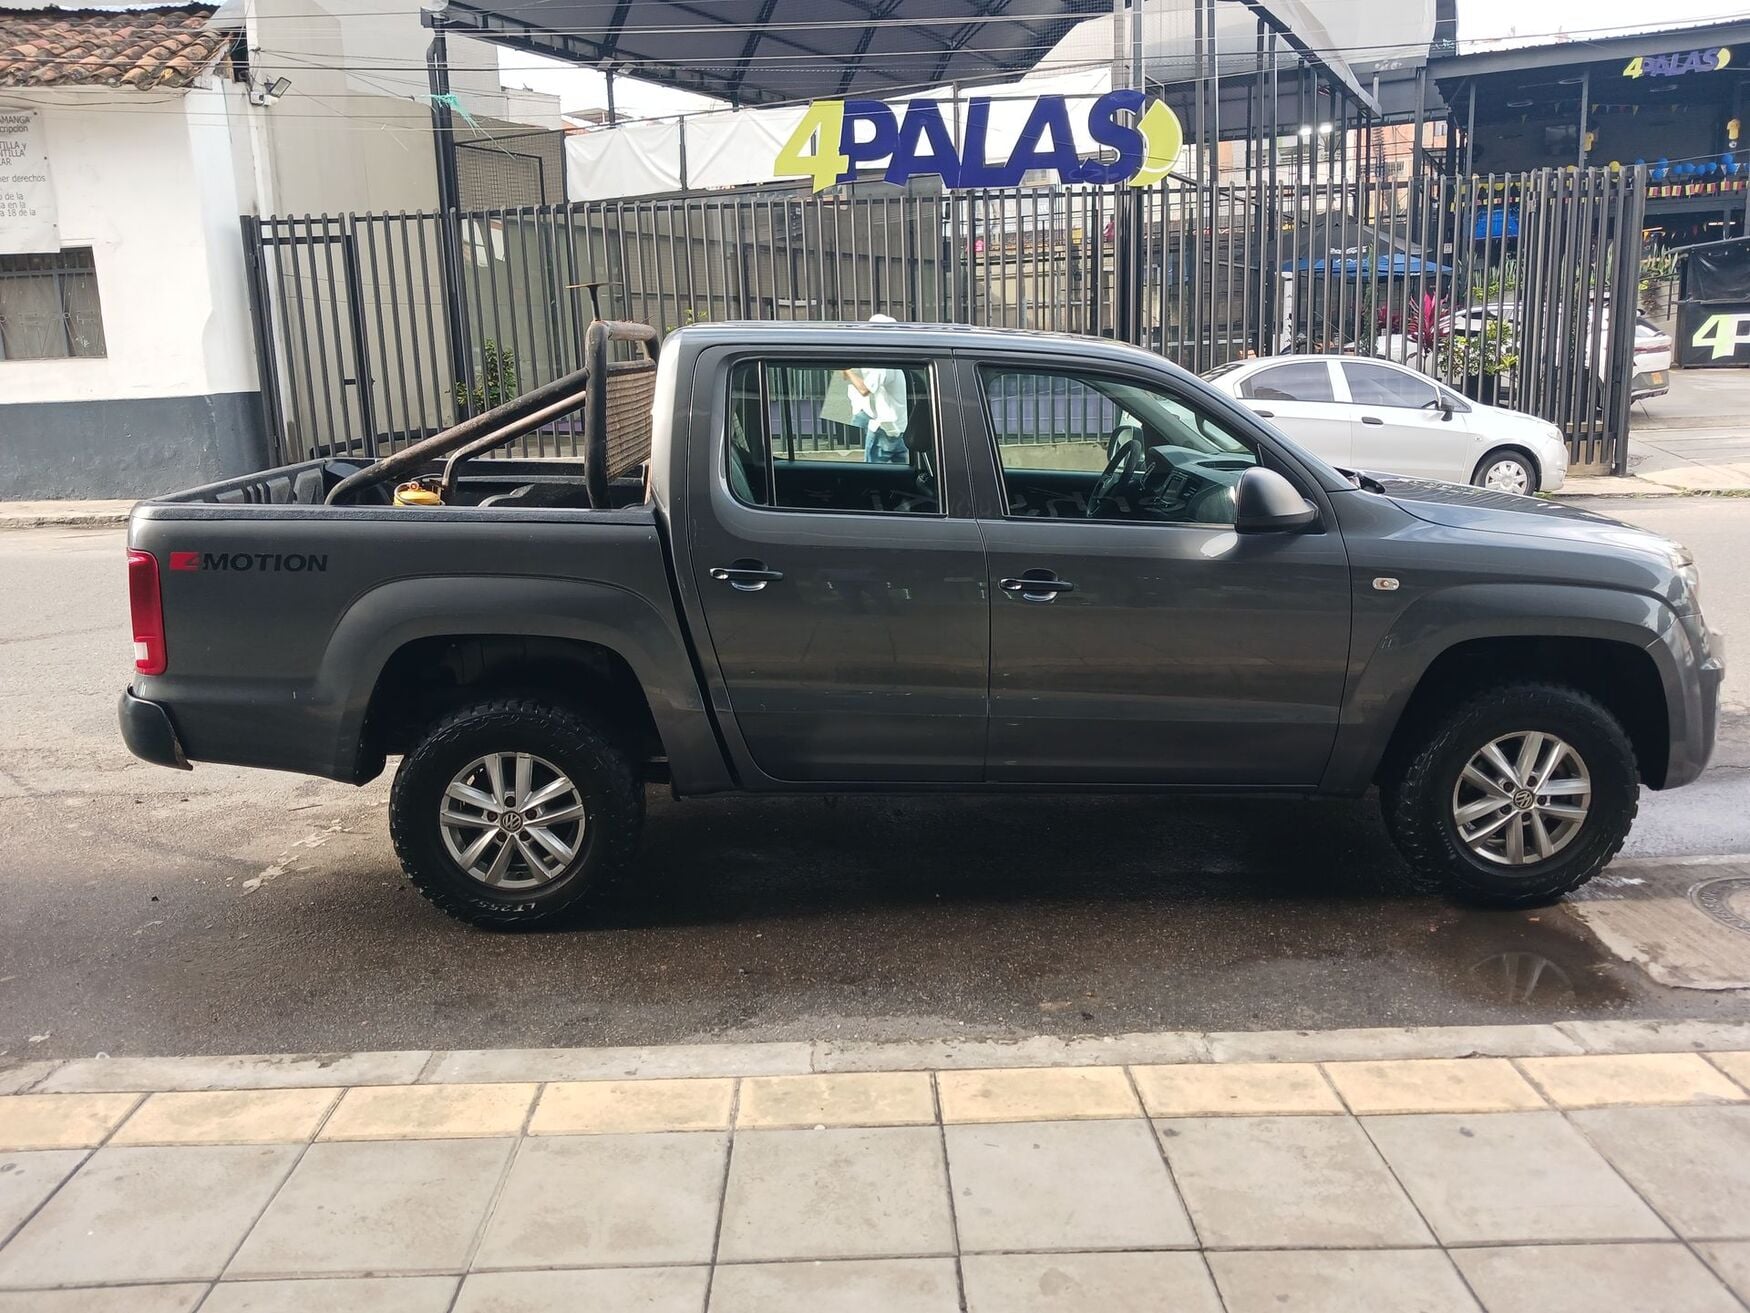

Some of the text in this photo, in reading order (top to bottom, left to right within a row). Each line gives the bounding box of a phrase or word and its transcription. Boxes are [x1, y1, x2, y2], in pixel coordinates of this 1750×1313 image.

[1622, 47, 1720, 79] 4PALAS
[773, 89, 1147, 193] 4PALAS
[11, 173, 47, 183] derechos
[5, 193, 14, 201] de
[16, 192, 24, 200] la
[20, 201, 26, 209] la
[8, 208, 17, 217] 18
[19, 209, 28, 217] de
[29, 208, 37, 216] la
